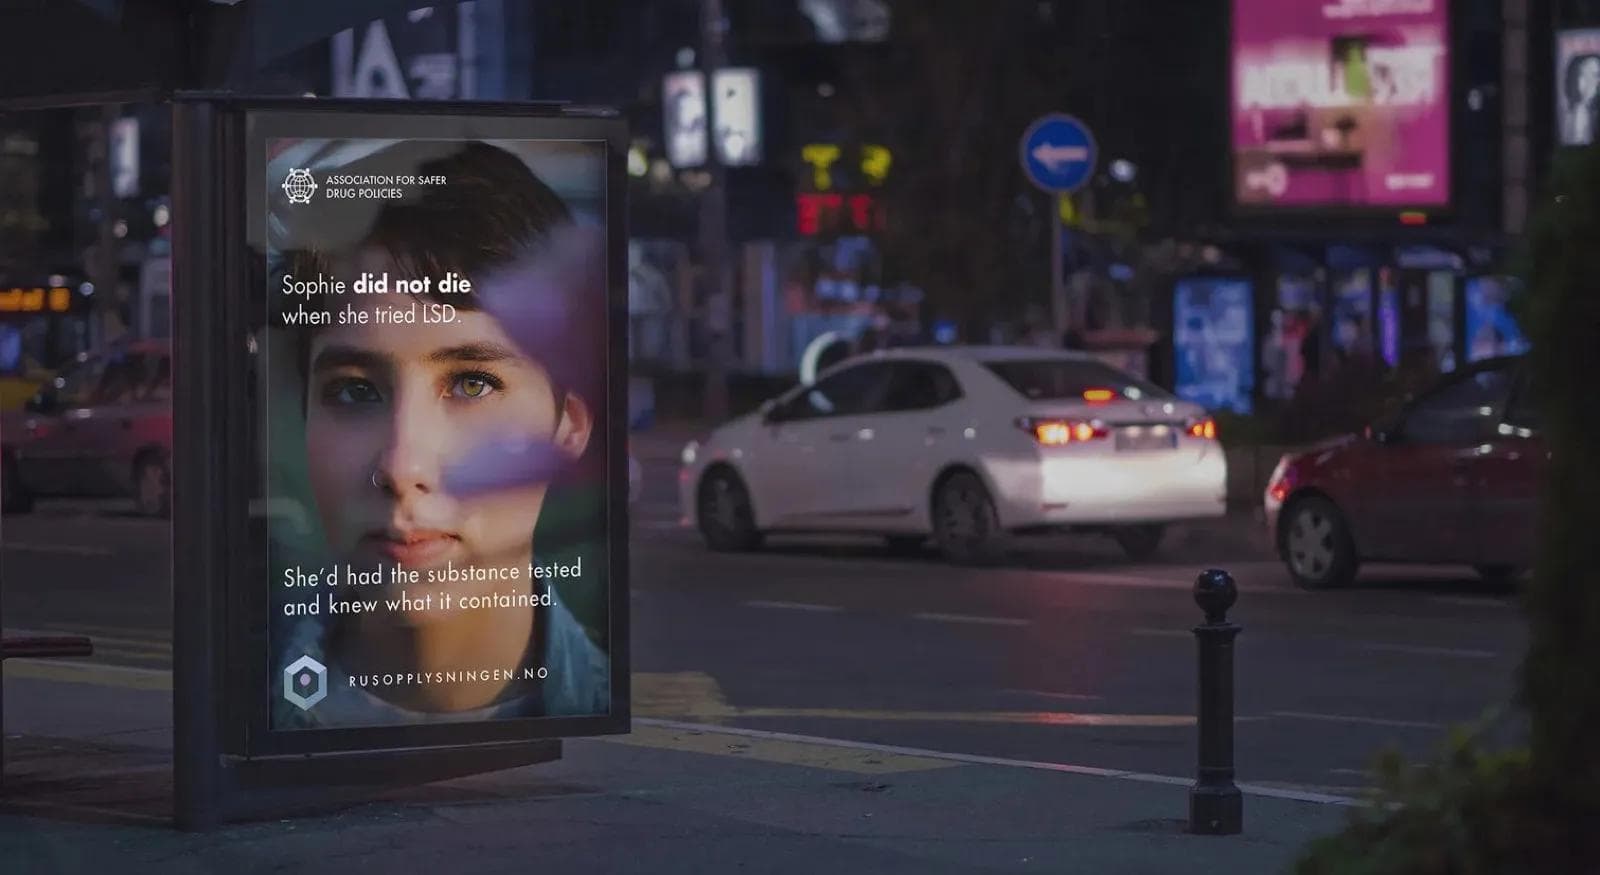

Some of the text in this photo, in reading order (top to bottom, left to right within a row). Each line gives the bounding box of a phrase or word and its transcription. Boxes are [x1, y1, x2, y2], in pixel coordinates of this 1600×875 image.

[325, 175, 447, 186] ASSOCIATION FOR SAFER
[326, 187, 403, 199] DRUG POLICIES
[282, 271, 472, 301] Sophie did not die
[281, 302, 462, 325] when she tried LSD.
[283, 556, 582, 588] She'd had the substance tested
[283, 584, 558, 617] and knew what it contained.
[349, 666, 548, 687] RUSOPPLYSNINGEN.NO
